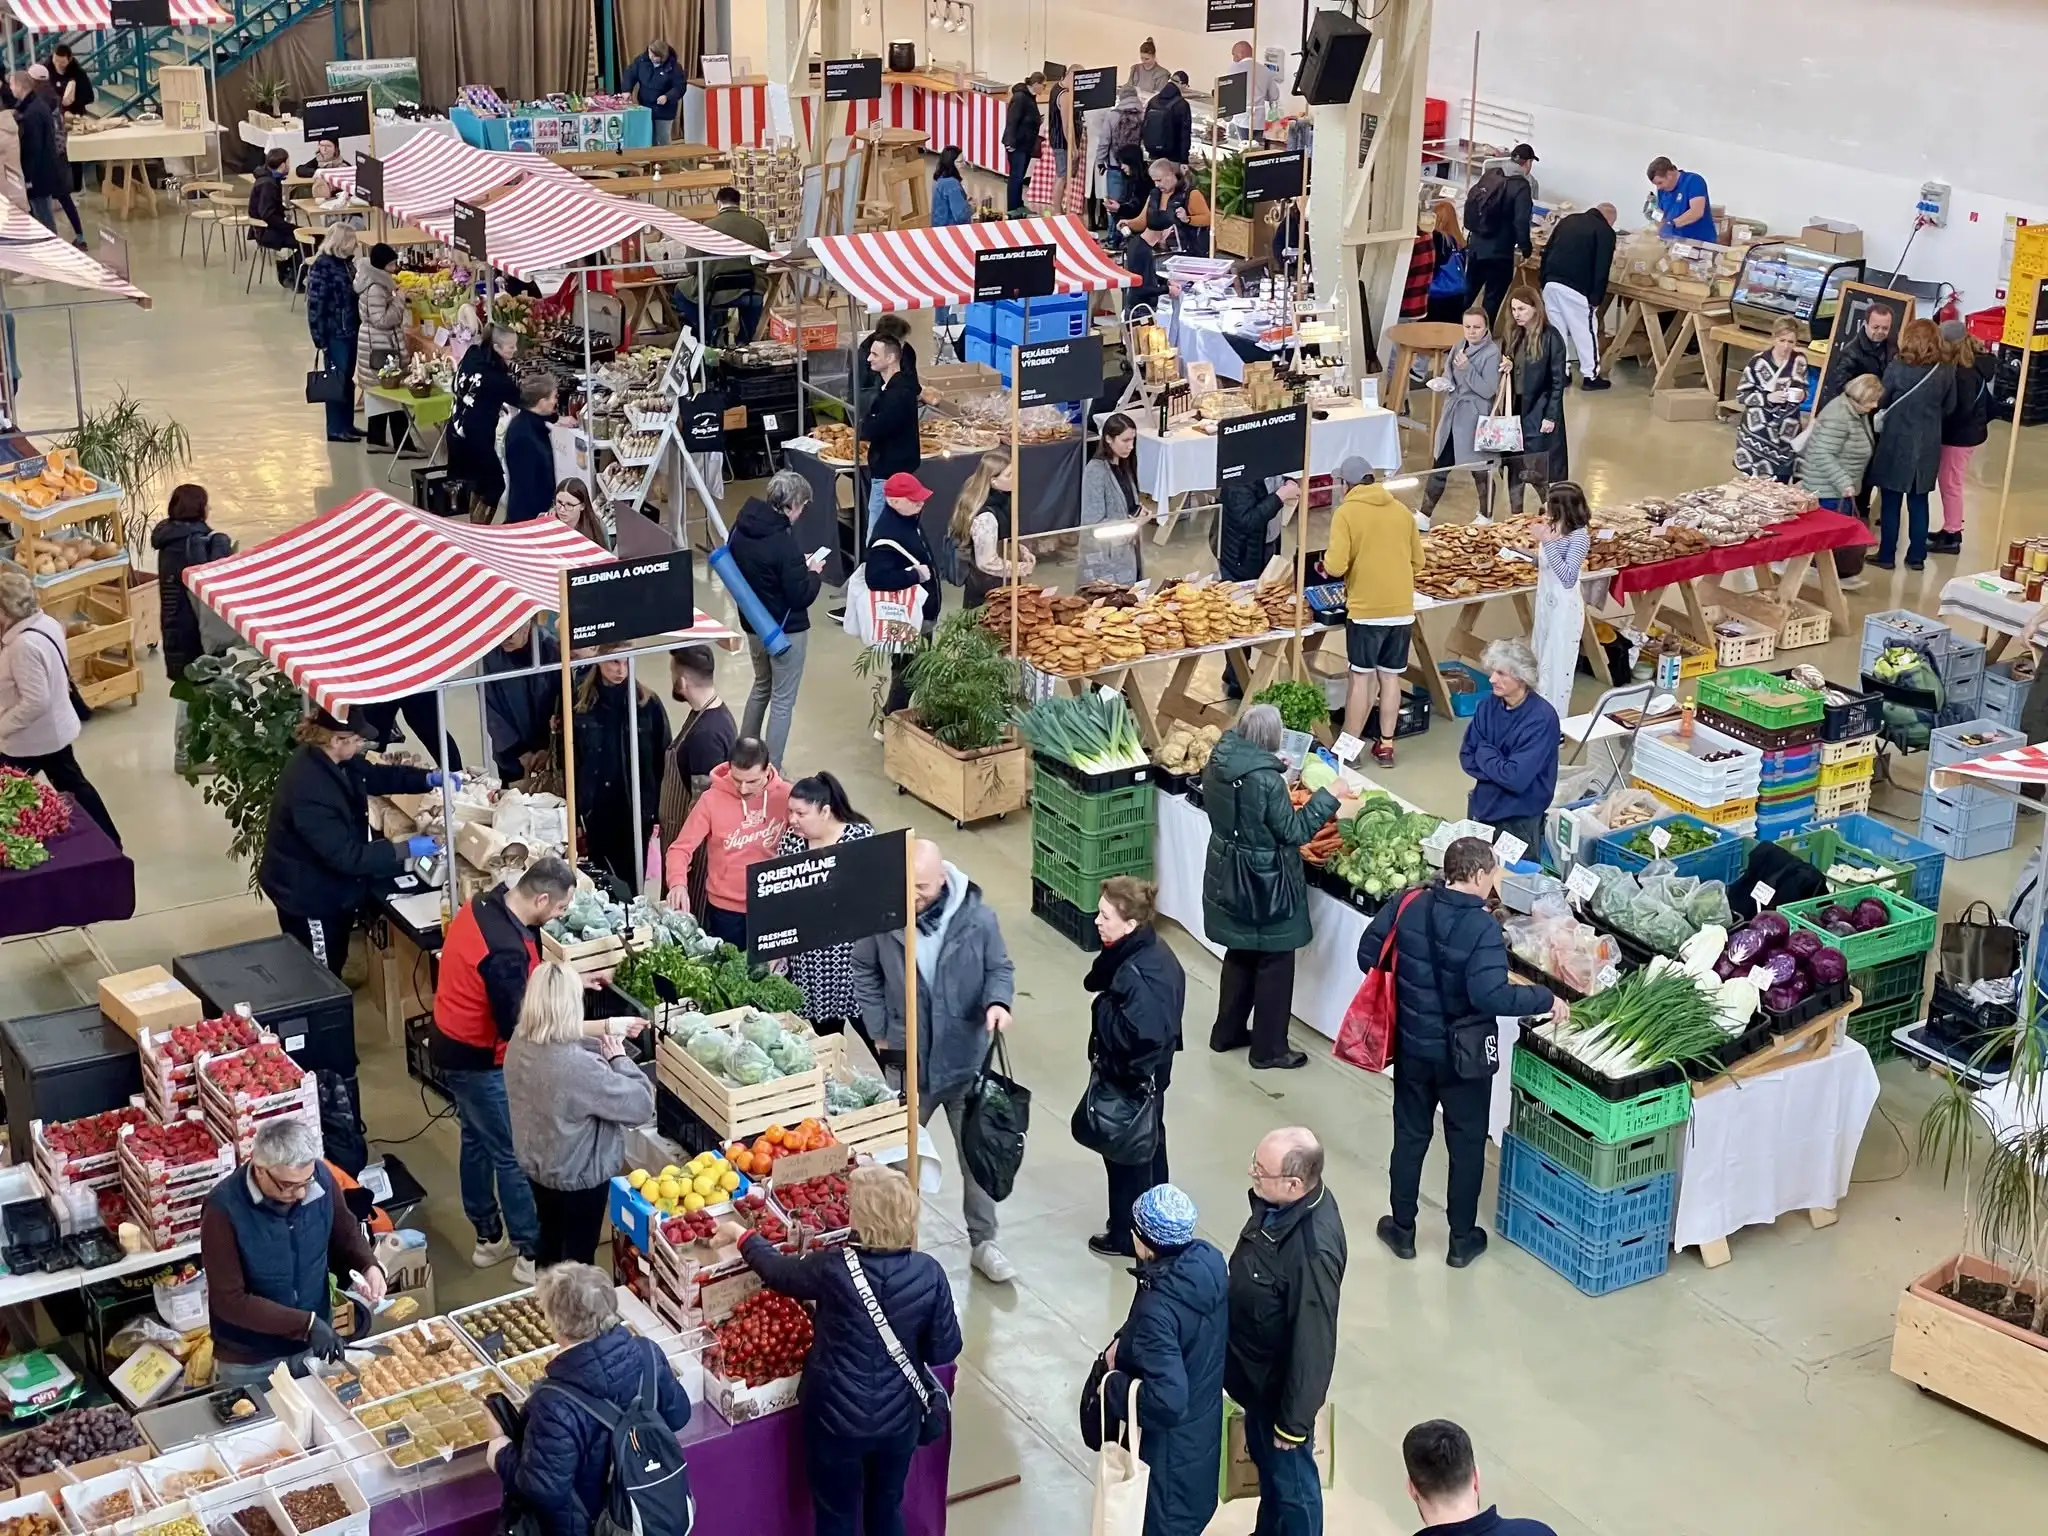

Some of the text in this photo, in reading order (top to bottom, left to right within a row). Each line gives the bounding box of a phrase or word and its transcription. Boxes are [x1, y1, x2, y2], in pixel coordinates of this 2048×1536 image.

[979, 248, 1049, 262] BRATISLAVSKÉ ROŽKY
[1297, 303, 1314, 312] CBD
[1021, 344, 1070, 359] PEKÁRENSKÉ
[1021, 356, 1057, 368] VÝROBKY
[1268, 412, 1297, 426] OVOCIE
[571, 561, 670, 587] ZELENINA A OVOCIE
[573, 621, 616, 635] DREAM FARM
[723, 815, 787, 851] Superdry
[757, 855, 837, 885] ORIENTÁLNE
[757, 870, 830, 898] ŠPECIALITY
[758, 928, 798, 944] FRESHEES
[758, 935, 799, 951] PRIEVIDZA
[1485, 1034, 1497, 1064] EA7
